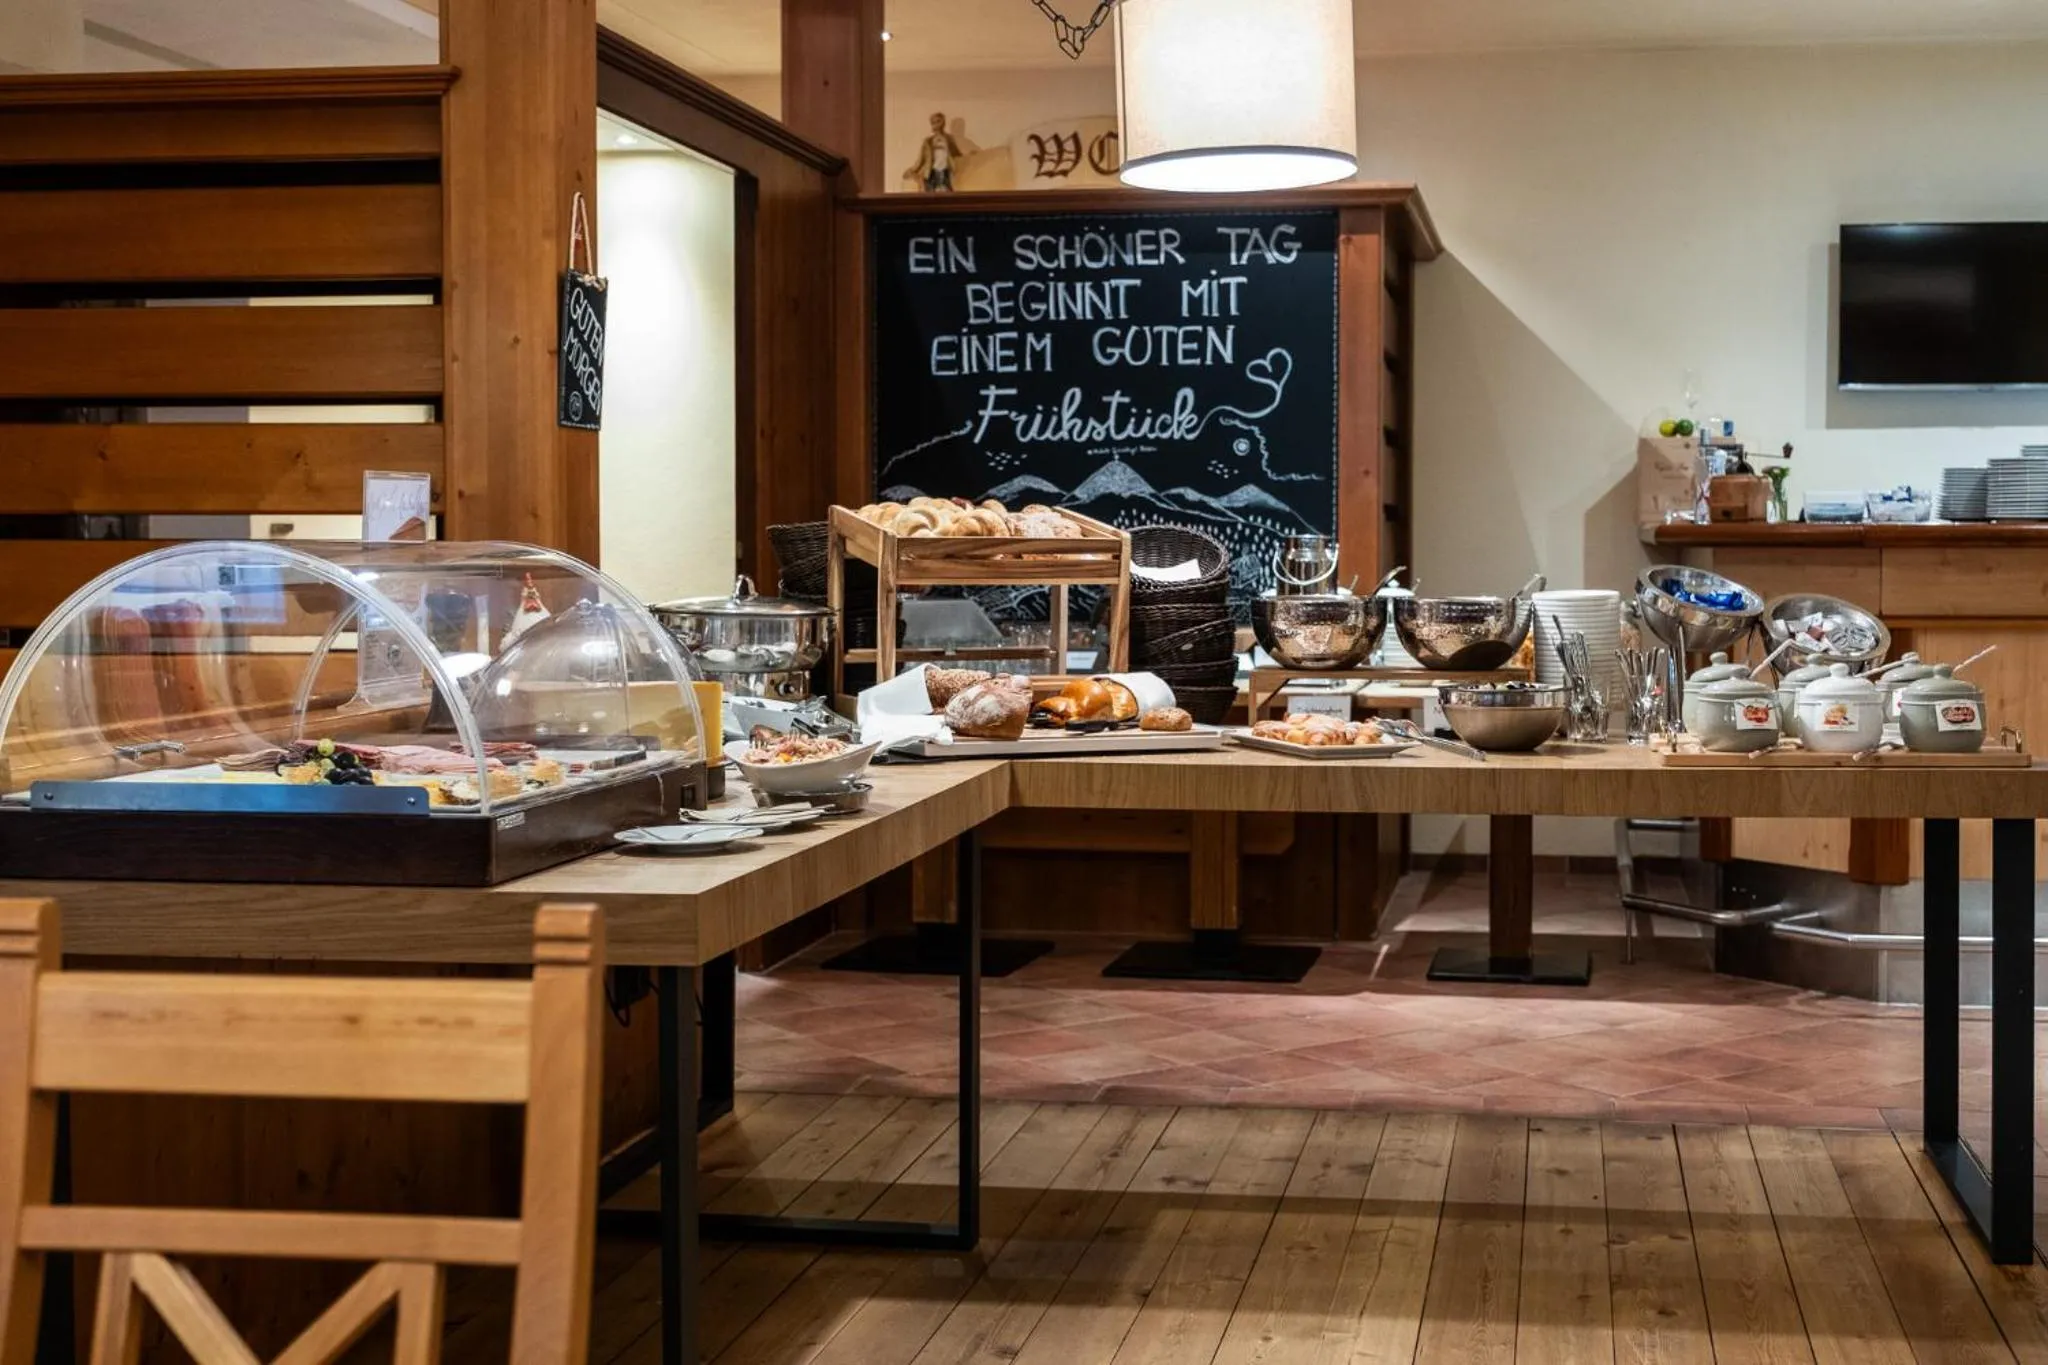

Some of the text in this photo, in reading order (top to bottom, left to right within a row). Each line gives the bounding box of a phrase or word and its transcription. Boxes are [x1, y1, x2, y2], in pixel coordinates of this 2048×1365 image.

[1013, 225, 1187, 271] SCHÖNER
[1216, 223, 1303, 266] TAG
[965, 272, 1142, 325] BEGINNT
[930, 324, 1237, 376] EINEM GUTEN
[972, 384, 1201, 445] Frühstück
